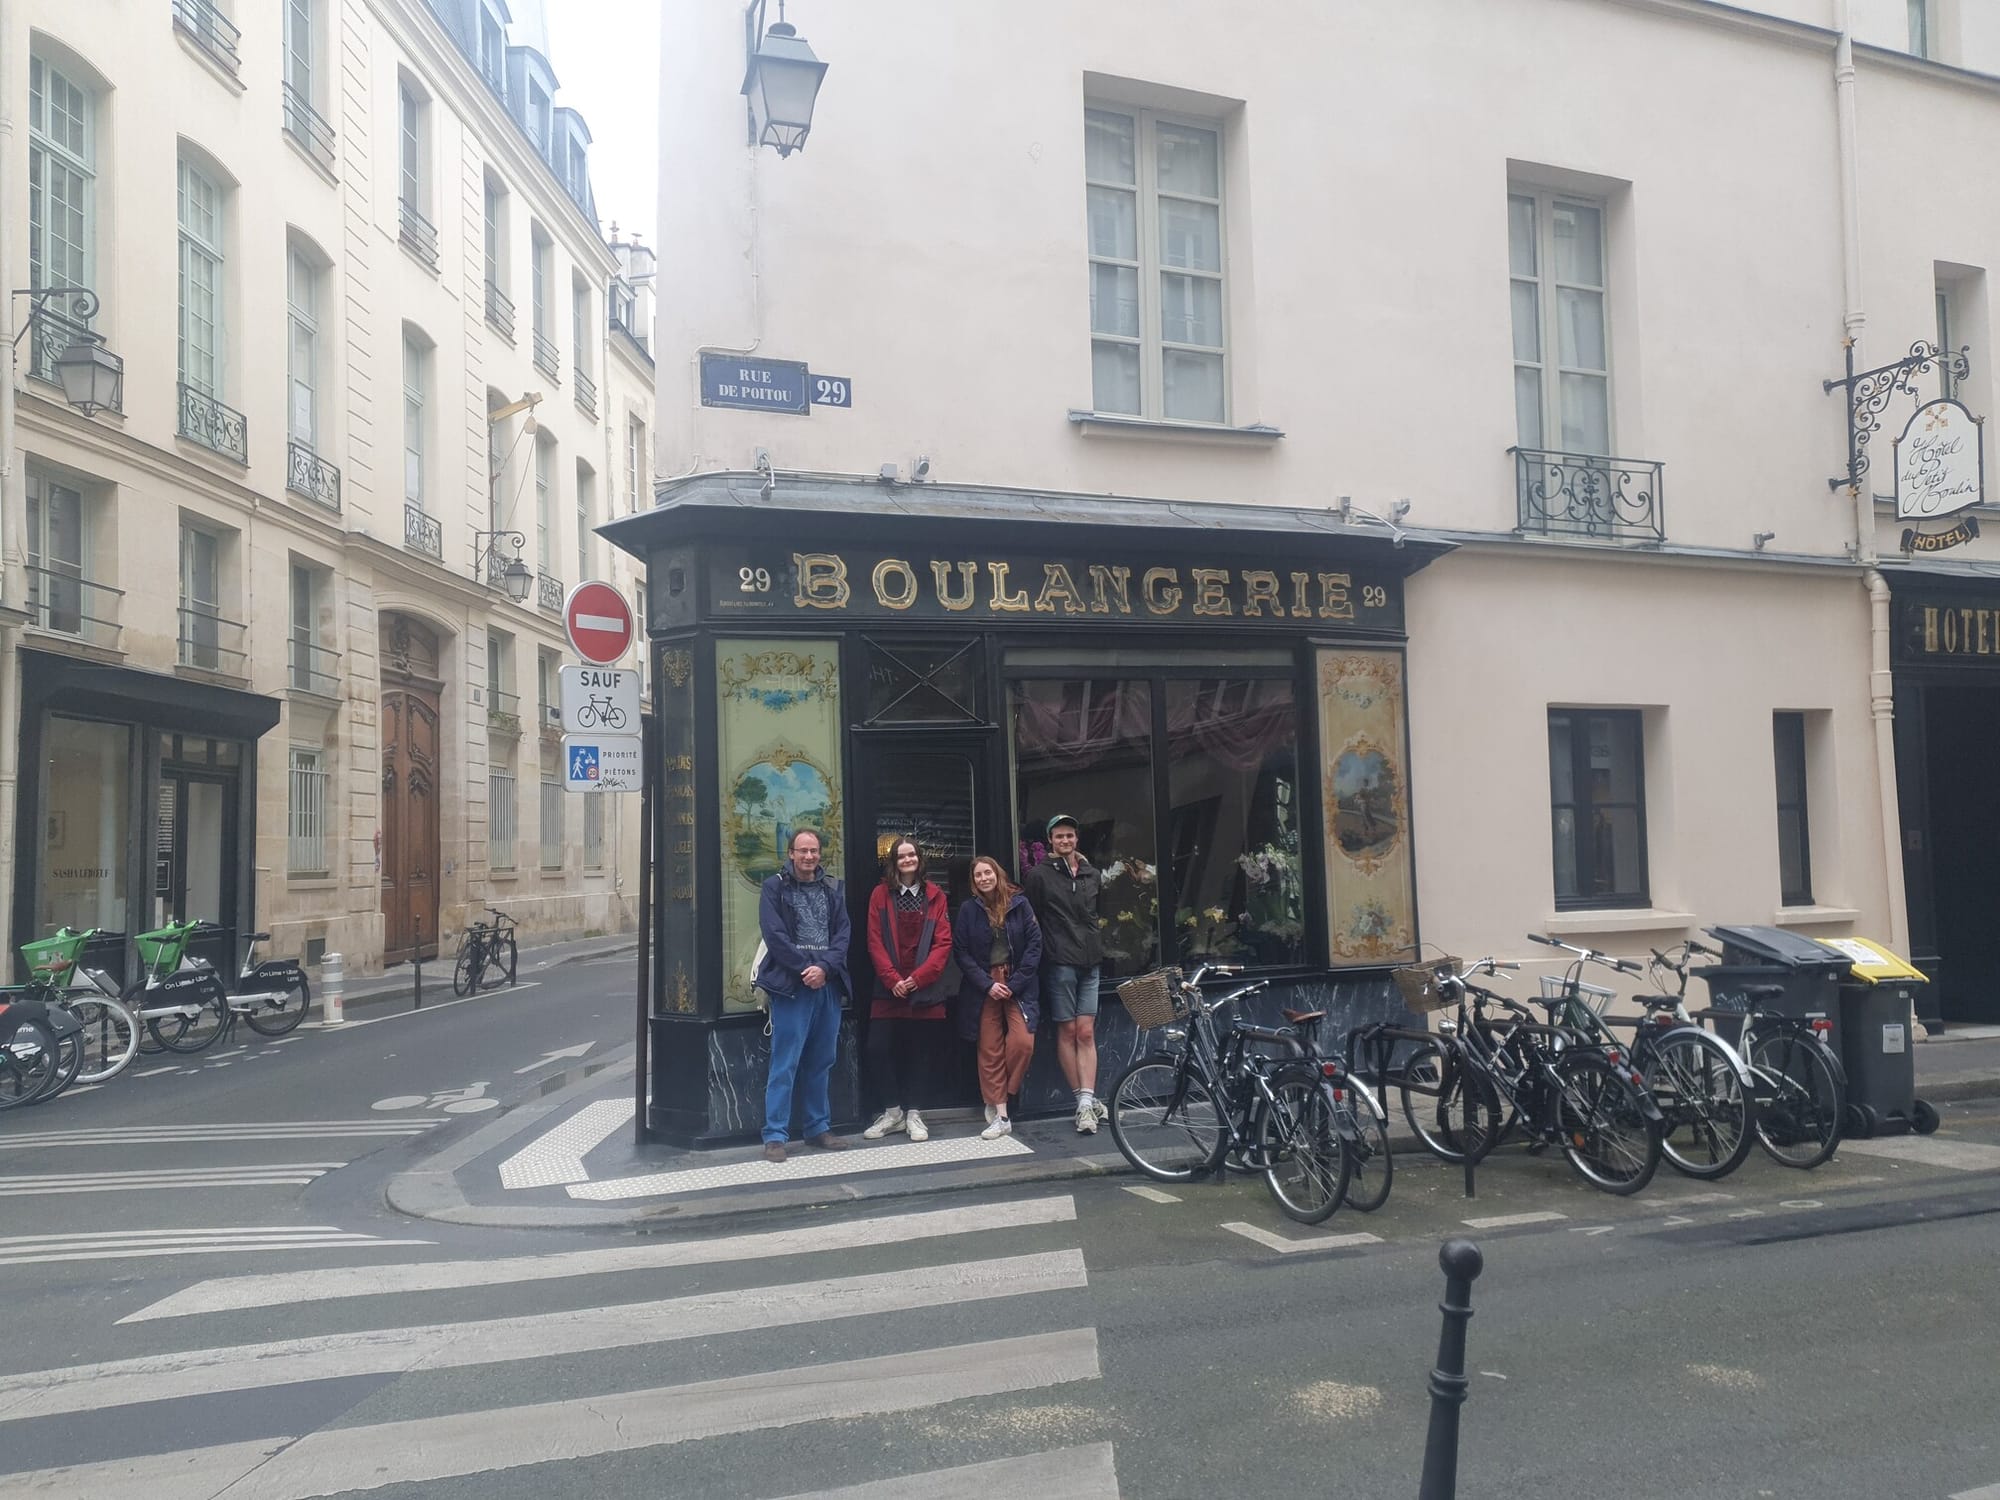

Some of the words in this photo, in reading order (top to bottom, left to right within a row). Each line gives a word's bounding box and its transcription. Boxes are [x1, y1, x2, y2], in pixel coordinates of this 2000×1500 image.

[739, 368, 772, 384] RUE
[718, 384, 739, 397] DE
[741, 387, 792, 402] POITOU
[816, 379, 846, 404] 29
[739, 567, 771, 592] 29
[793, 552, 1354, 619] BOULANGERIE
[1362, 585, 1387, 608] 29
[581, 671, 621, 688] SAUF
